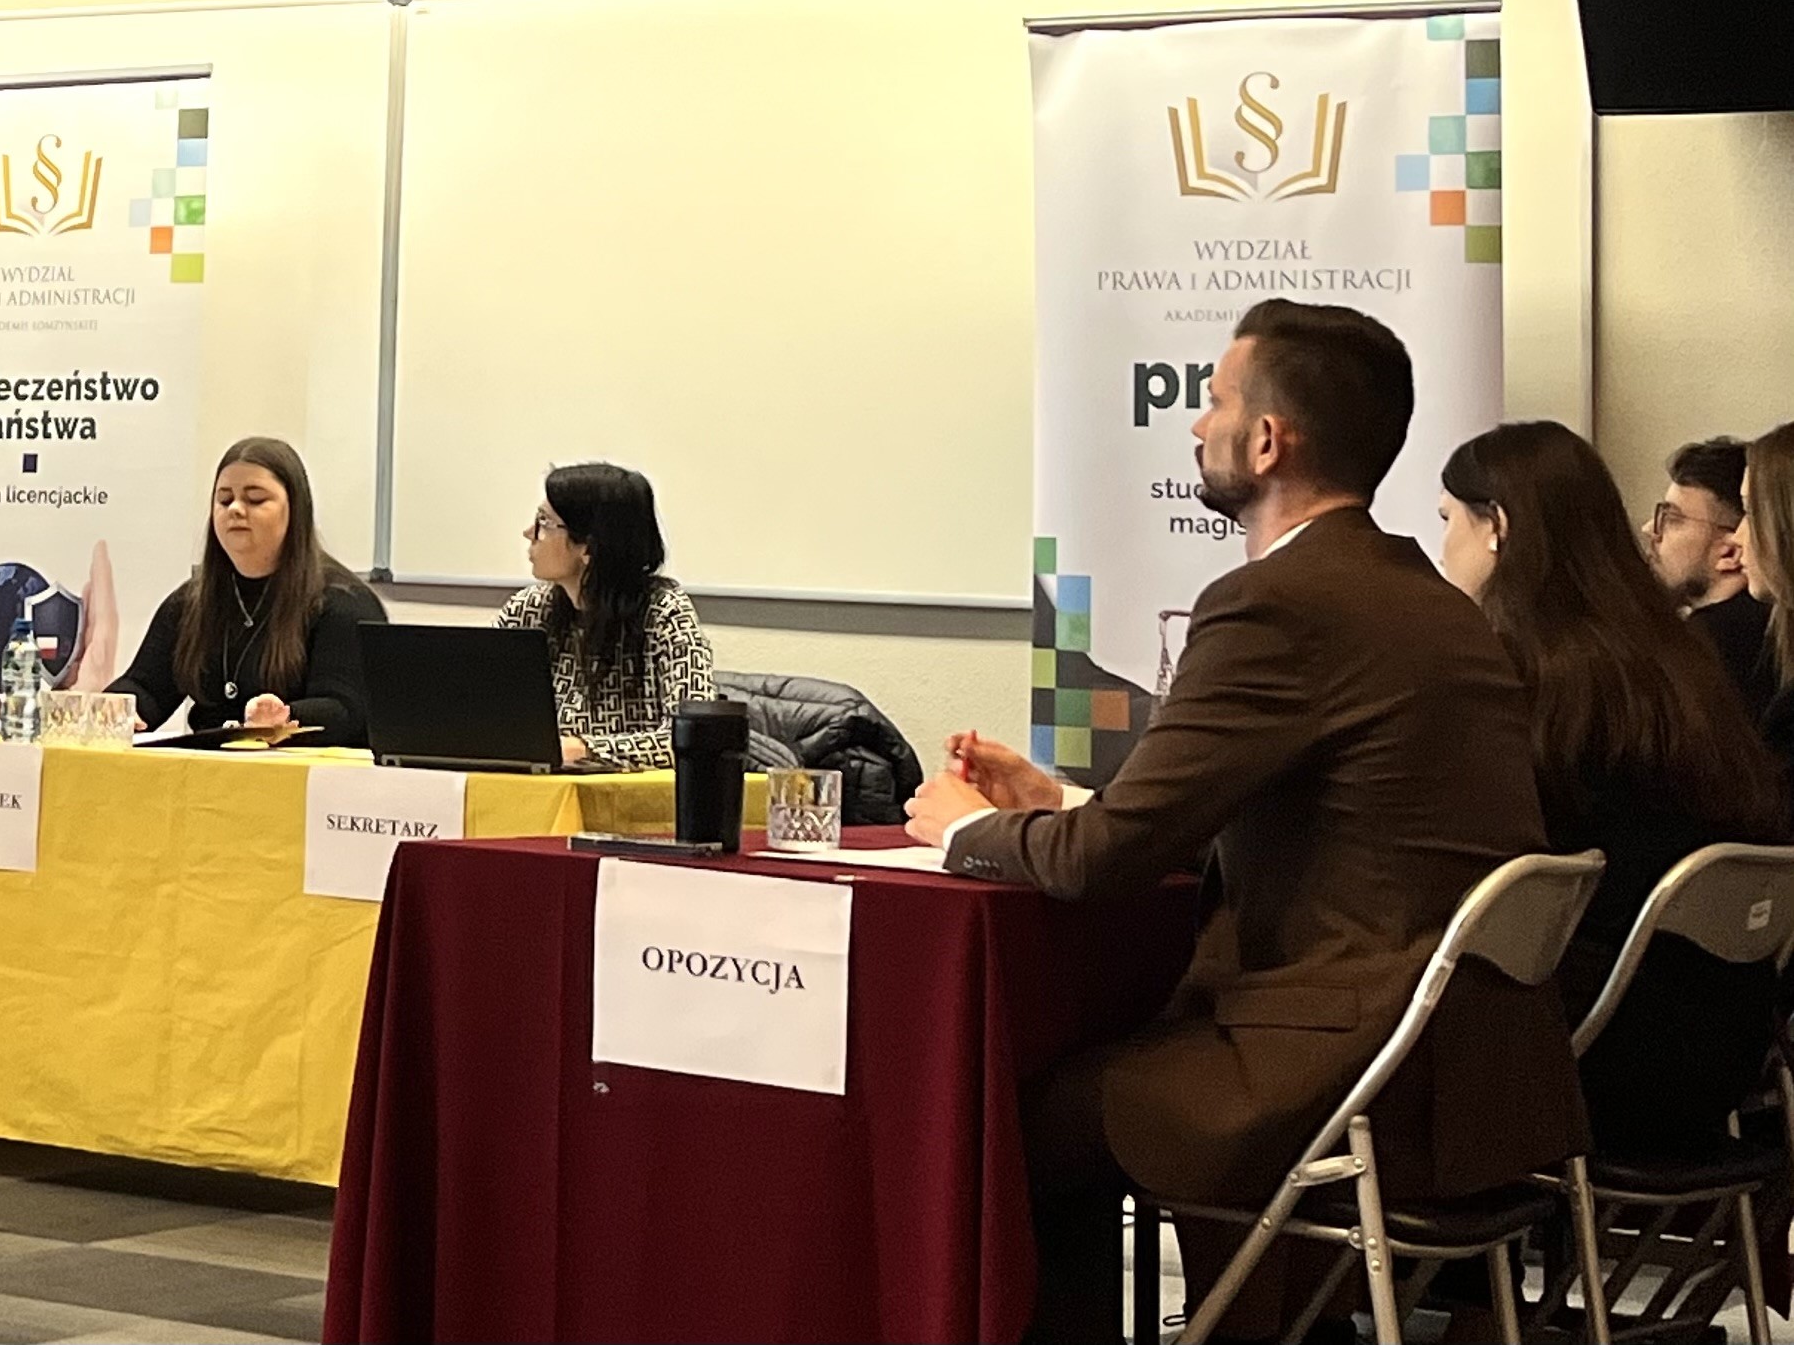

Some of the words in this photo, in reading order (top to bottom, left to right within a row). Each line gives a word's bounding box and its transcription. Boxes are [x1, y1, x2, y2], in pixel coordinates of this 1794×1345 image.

[1193, 239, 1312, 261] WYDZIAŁ
[1097, 270, 1182, 291] PRAWA
[1205, 268, 1412, 294] ADMINISTRACJI
[7, 287, 135, 307] ADMINISTRACJI
[6, 485, 108, 508] licencjackie
[326, 813, 439, 839] SEKRETARZ
[642, 946, 805, 995] OPOZYCJA
